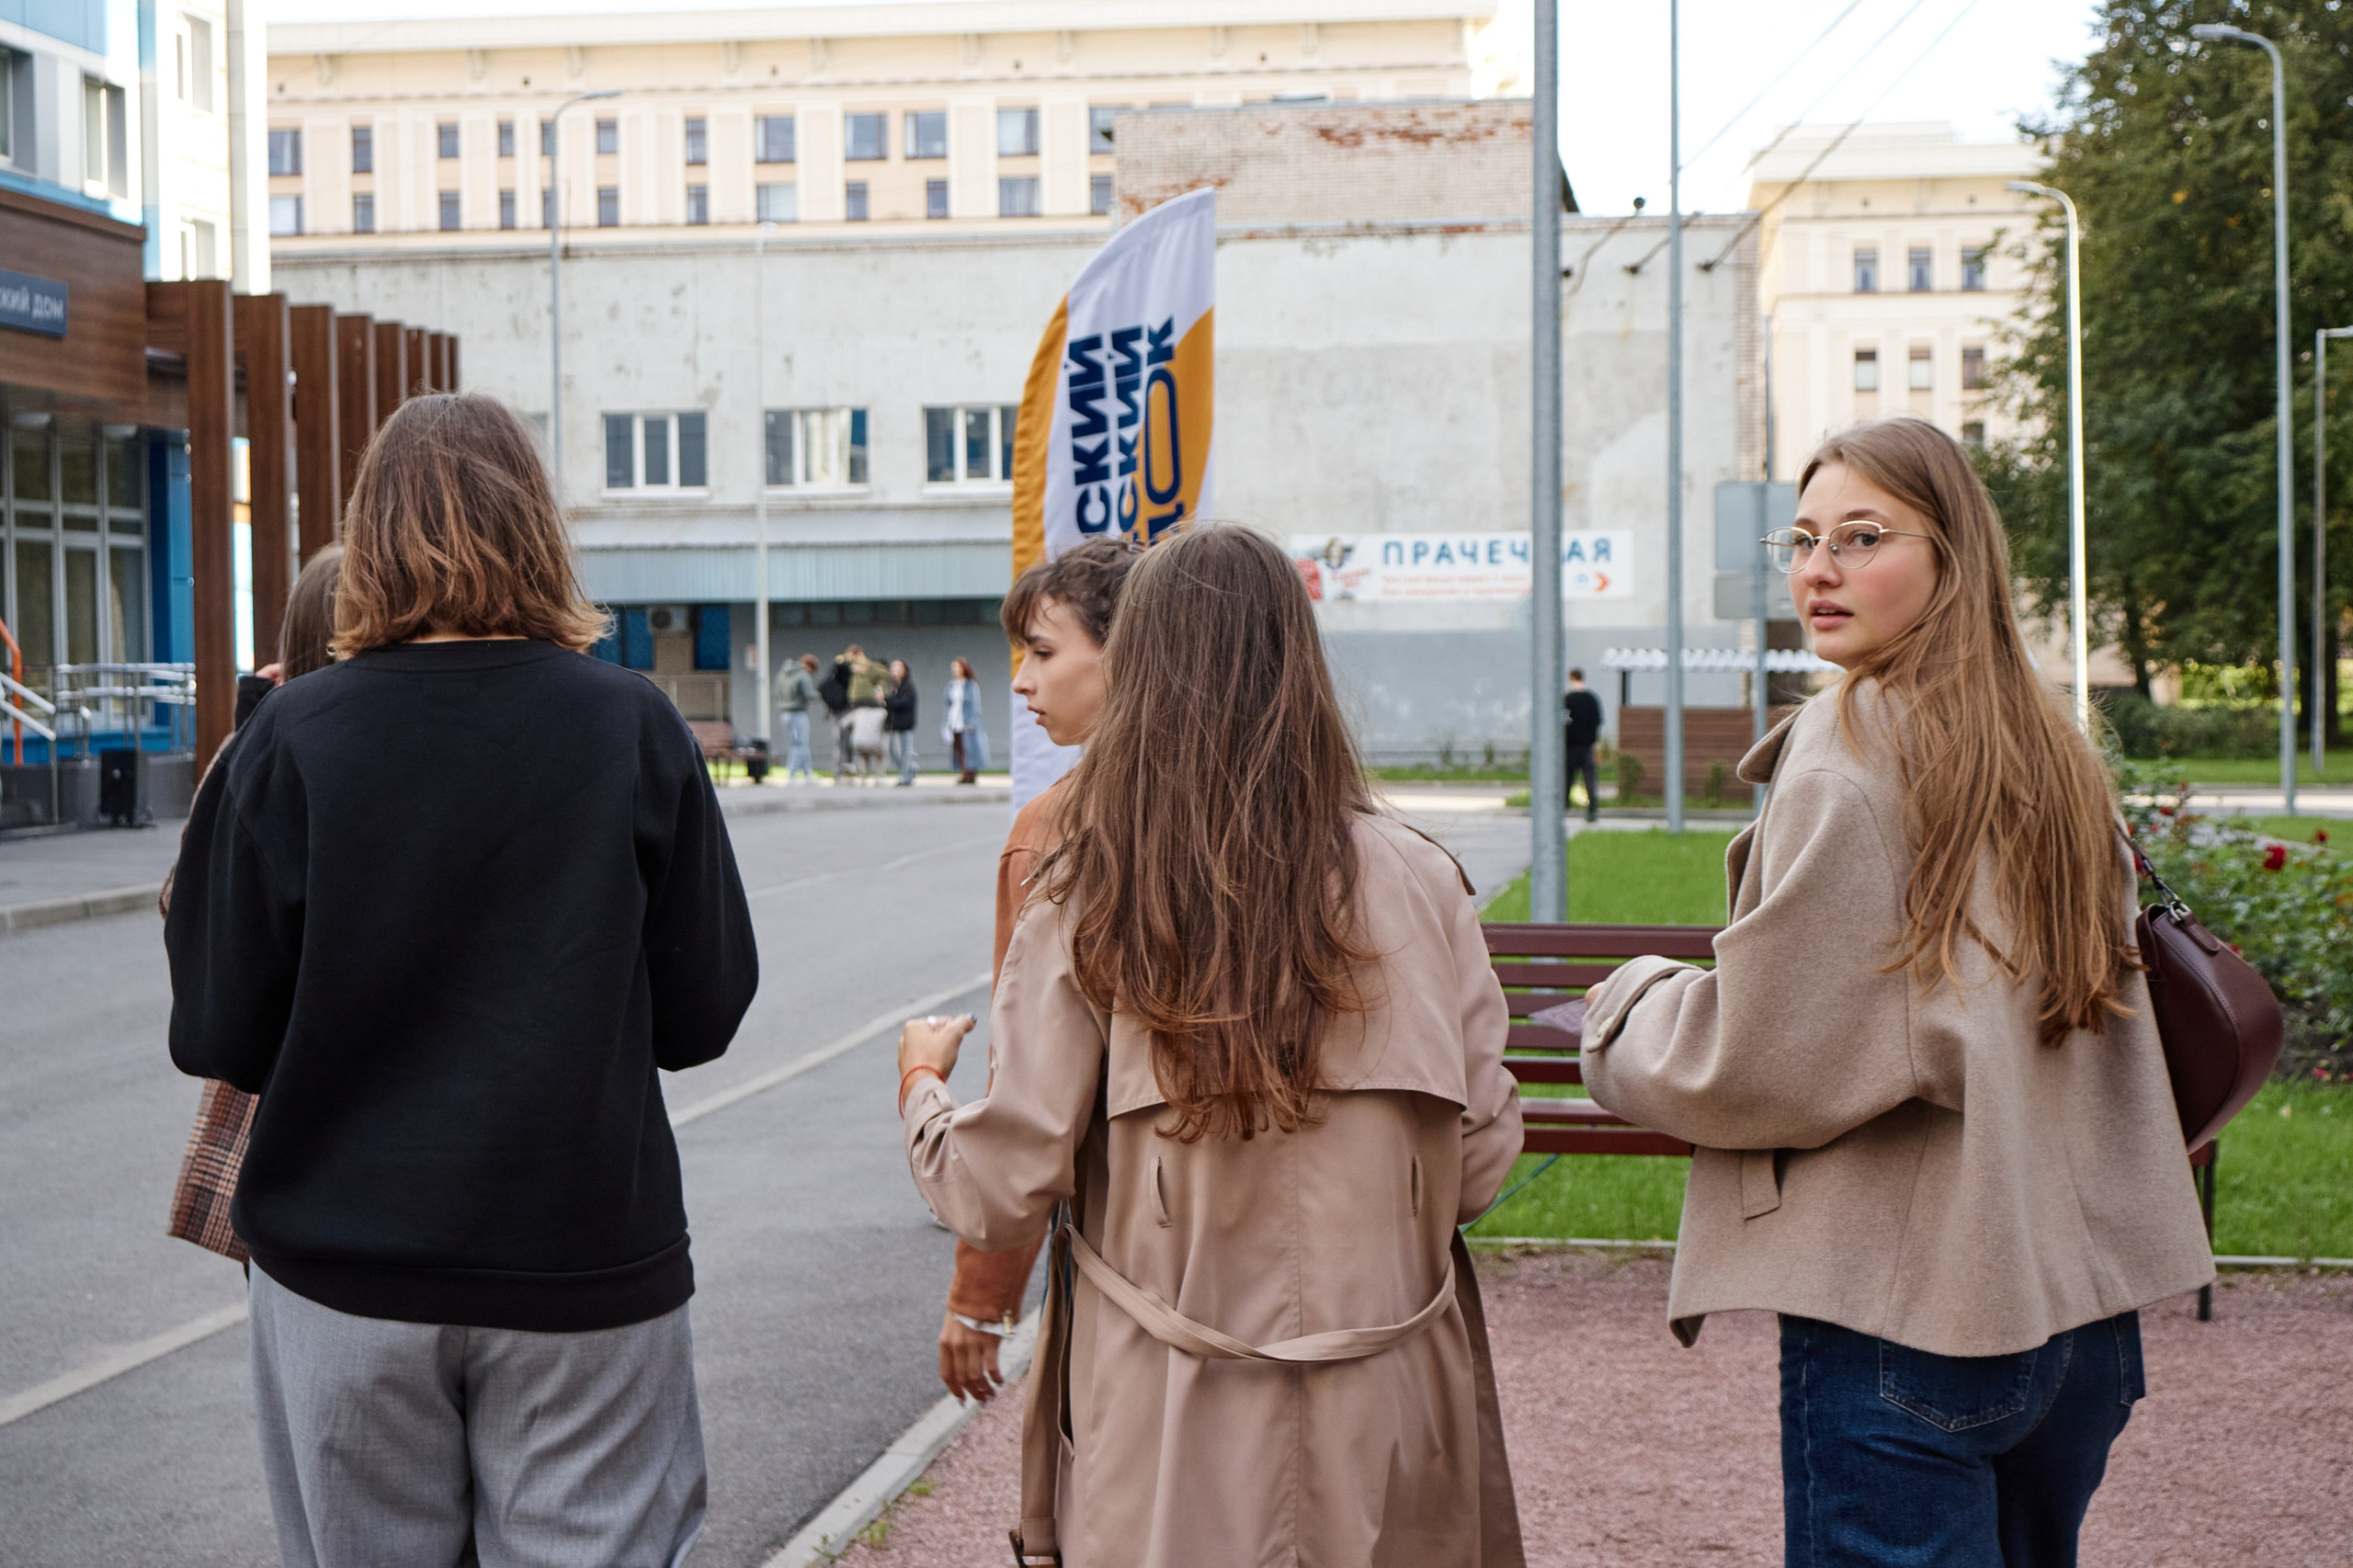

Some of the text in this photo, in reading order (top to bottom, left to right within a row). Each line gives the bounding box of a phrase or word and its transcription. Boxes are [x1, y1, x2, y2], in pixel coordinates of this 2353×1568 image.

[0, 286, 30, 312] КИЙ
[1108, 324, 1142, 543] СКИЙ
[1382, 538, 1611, 565] ПРАЧЕЧАЯ
